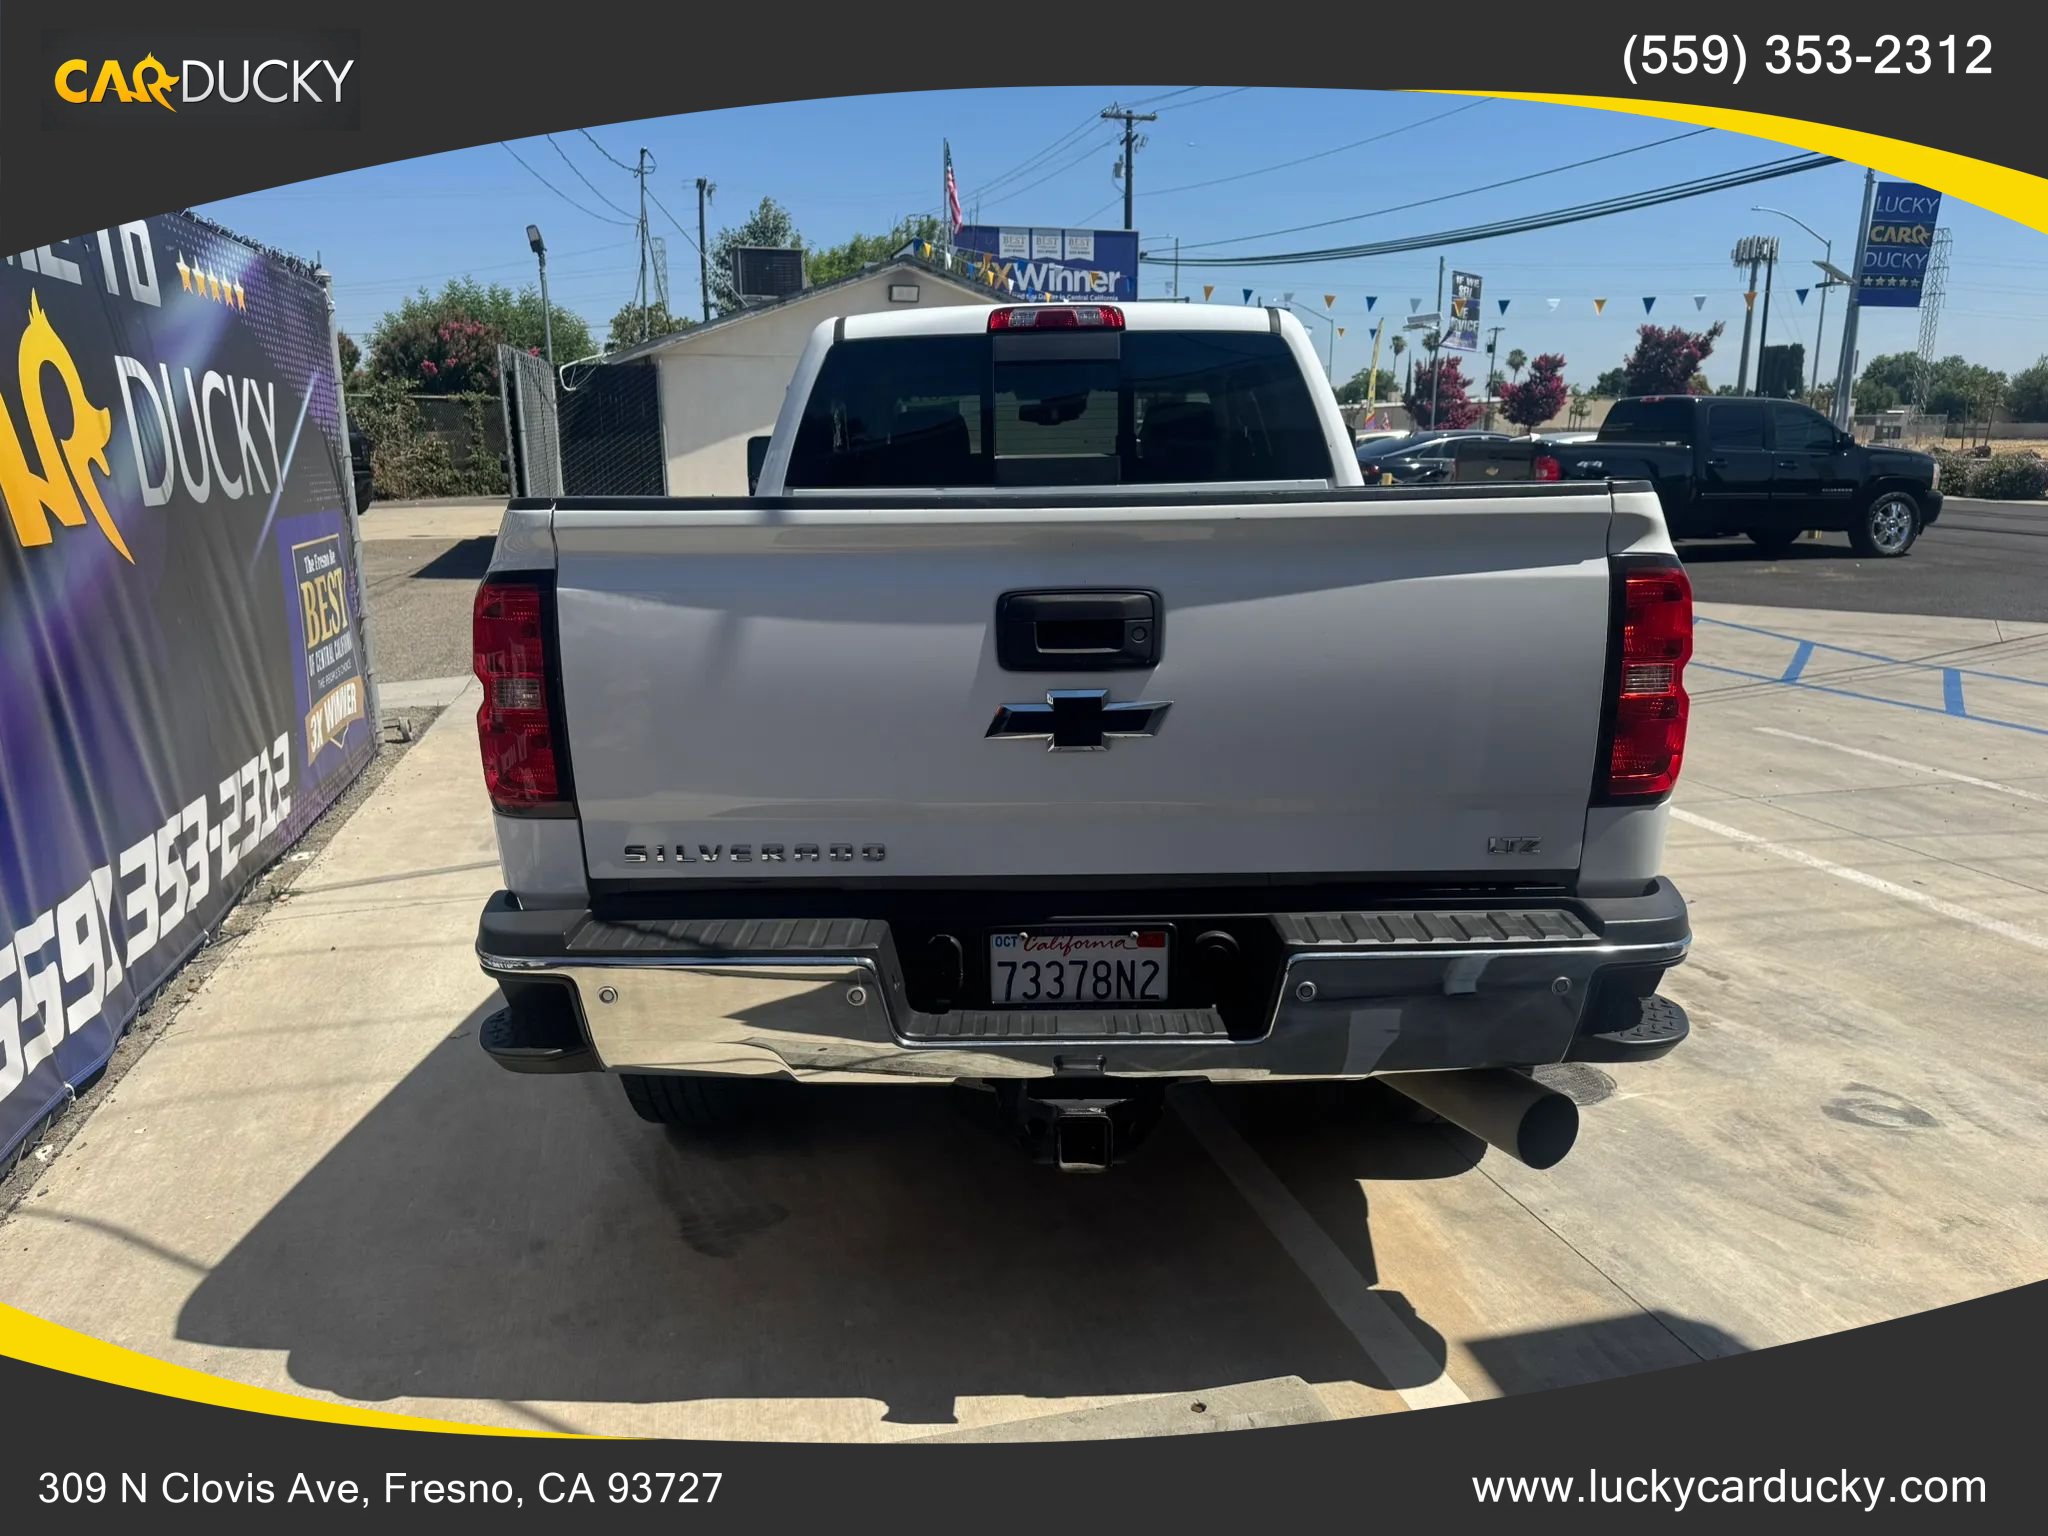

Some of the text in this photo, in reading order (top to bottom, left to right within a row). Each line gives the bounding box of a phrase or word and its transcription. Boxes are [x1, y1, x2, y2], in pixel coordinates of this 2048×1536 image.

[1876, 196, 1939, 214] LUCKY
[1864, 252, 1928, 269] DUCKY
[114, 355, 284, 507] DUCKY
[300, 567, 348, 649] BEST
[310, 682, 357, 753] 3X WINNER
[120, 731, 291, 969] 353-2312
[624, 843, 886, 864] SILVERADO
[1487, 836, 1541, 855] LTZ
[995, 935, 1138, 957] OCT California
[997, 959, 1160, 1001] 73378N2
